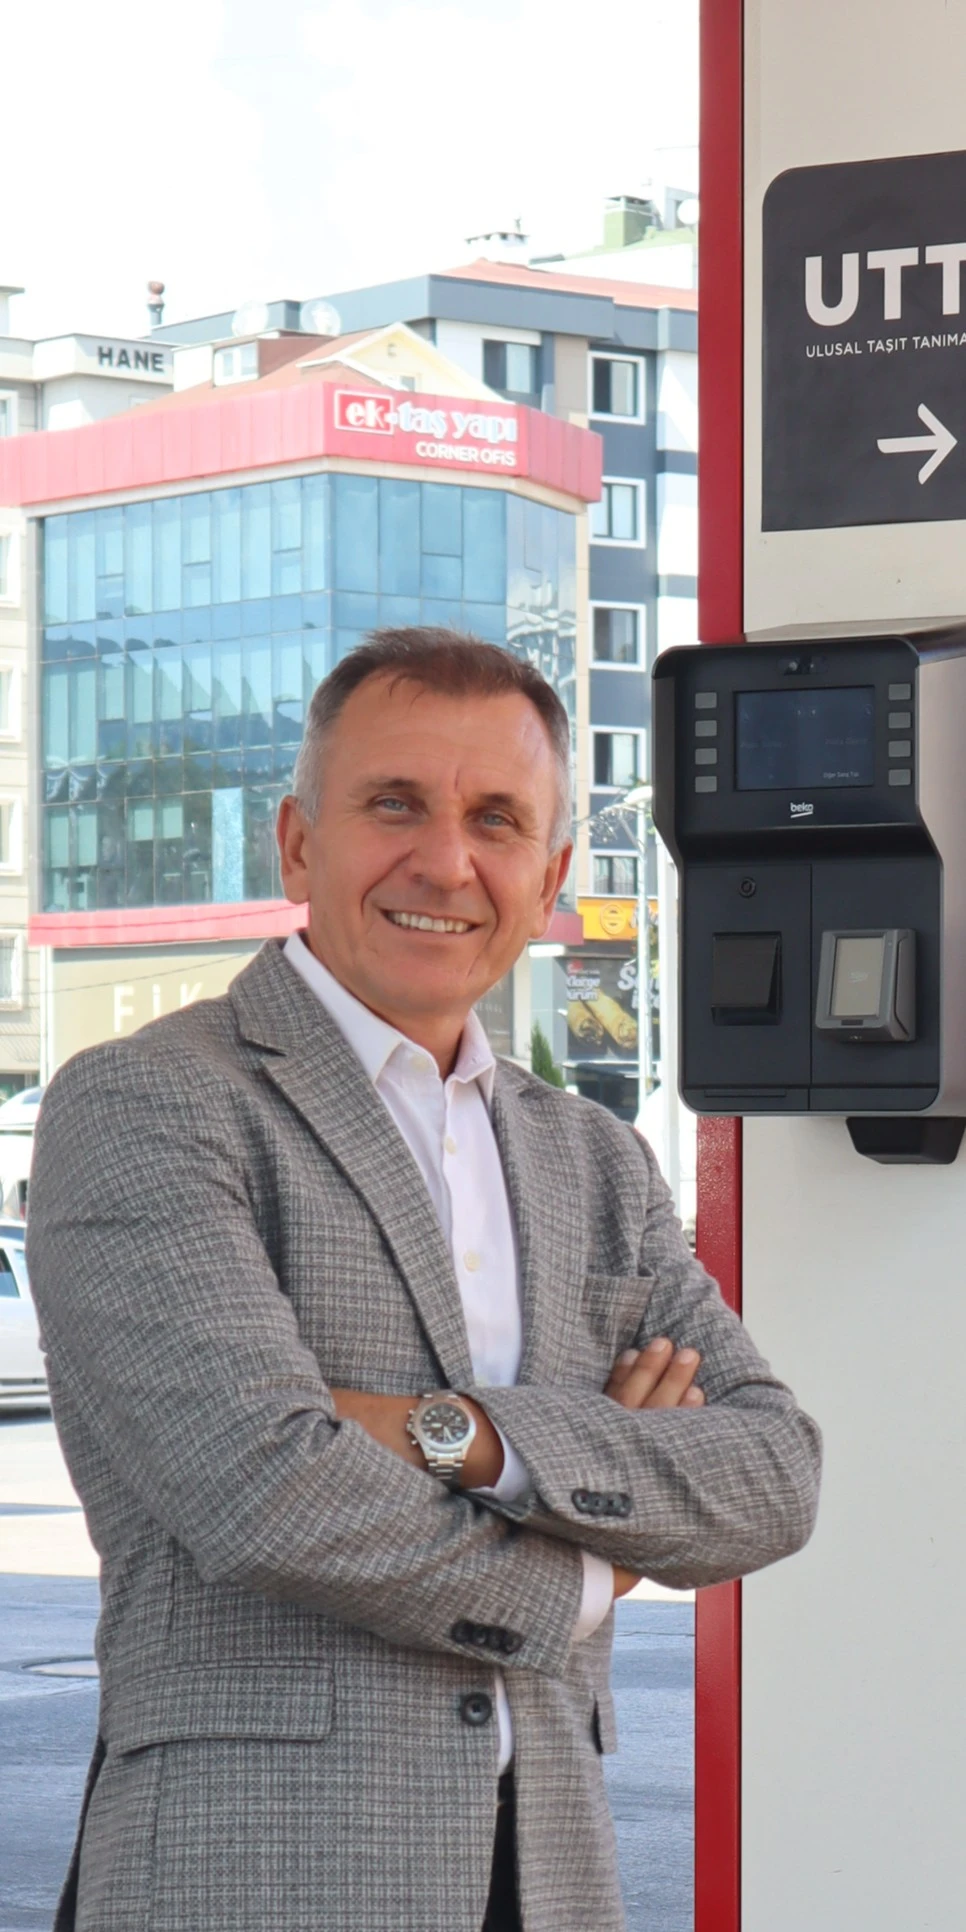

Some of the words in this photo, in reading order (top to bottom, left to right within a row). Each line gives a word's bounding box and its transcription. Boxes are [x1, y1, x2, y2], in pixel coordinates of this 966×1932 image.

[805, 242, 966, 326] UTT
[98, 345, 164, 373] HANE
[806, 341, 862, 358] ULUSAL
[867, 338, 907, 353] TAŞIT
[450, 411, 517, 444] yapı
[416, 441, 479, 463] CORNER
[790, 802, 814, 816] beko
